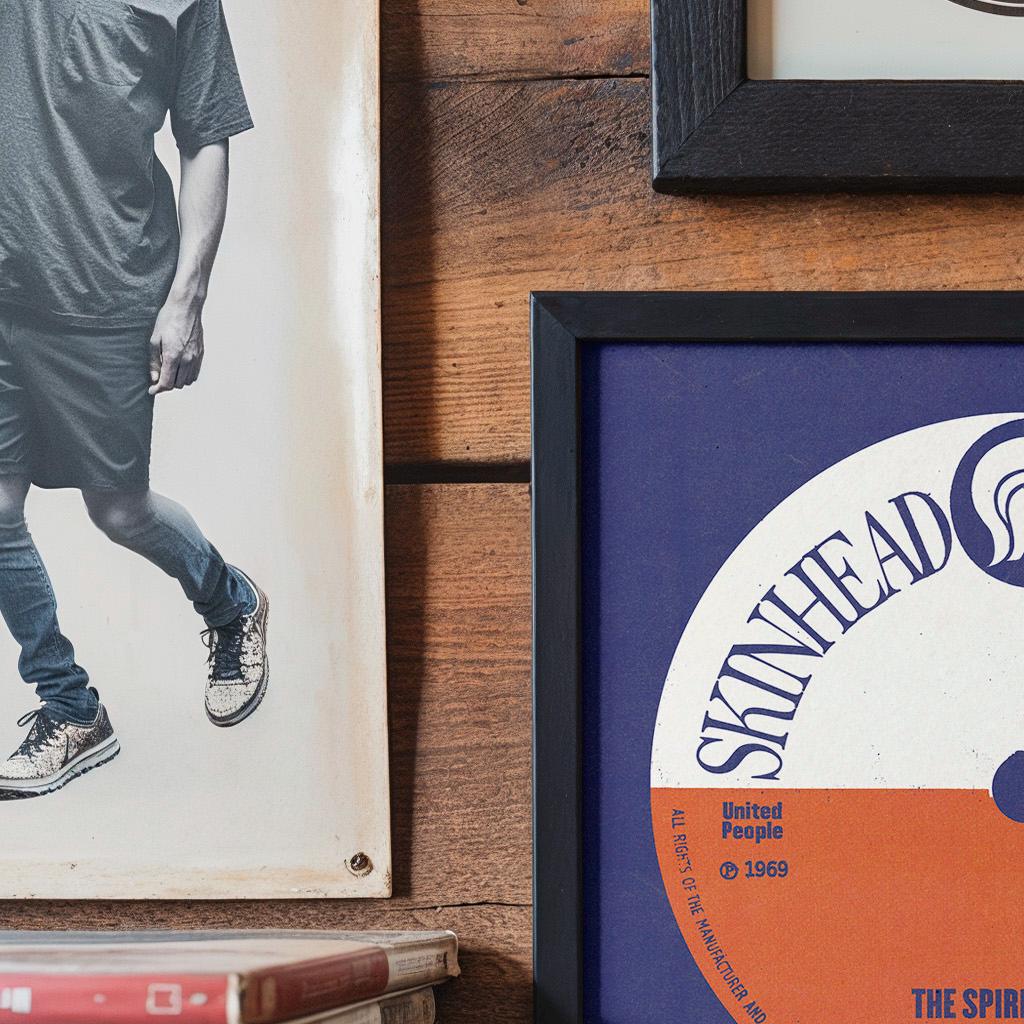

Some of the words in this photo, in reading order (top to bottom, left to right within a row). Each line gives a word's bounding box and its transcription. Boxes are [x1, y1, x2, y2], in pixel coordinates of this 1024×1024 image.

[696, 490, 952, 780] SKINHEAD
[672, 809, 685, 829] ALL
[723, 802, 782, 820] United
[722, 821, 783, 844] People
[674, 834, 692, 873] RIGHTS
[745, 860, 788, 878] 1969
[682, 877, 696, 891] OF
[688, 894, 704, 916] THE
[696, 919, 748, 1001] MANUFACTURER
[743, 1001, 766, 1024] AND
[912, 989, 956, 1018] THE
